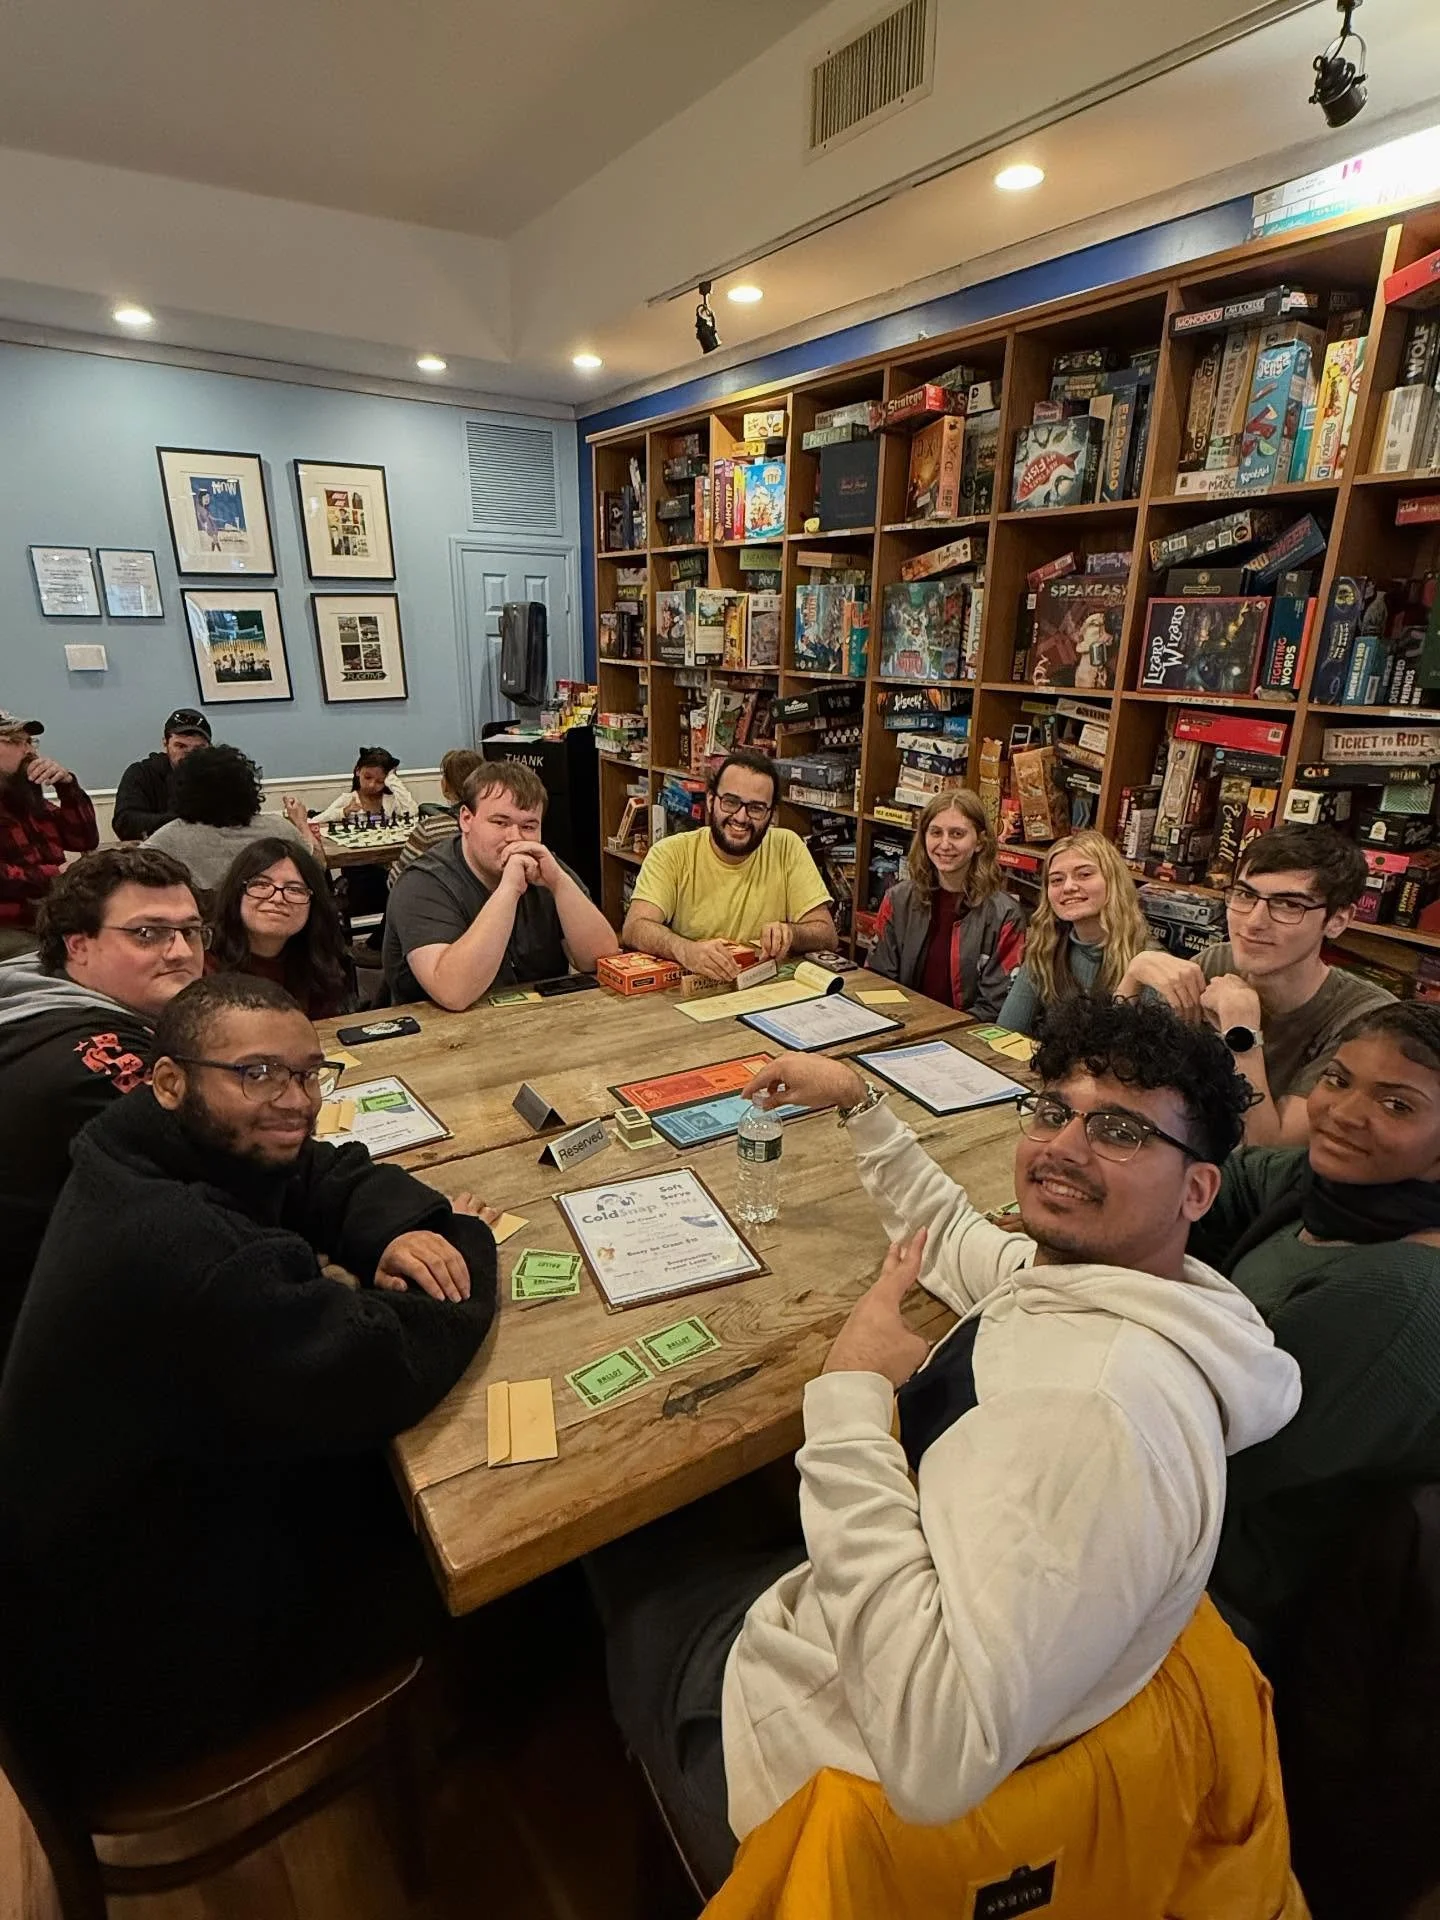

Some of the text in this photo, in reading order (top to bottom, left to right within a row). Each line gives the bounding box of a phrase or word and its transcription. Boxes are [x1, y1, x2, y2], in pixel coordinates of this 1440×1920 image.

[1176, 310, 1222, 329] MONOPOLY
[1407, 325, 1429, 378] WOLF
[887, 391, 924, 415] Stratego
[1108, 426, 1127, 490] DORADO
[211, 481, 237, 497] NOW
[724, 483, 734, 529] IMHOTEP
[1050, 584, 1127, 598] SPEAKEASY
[1271, 636, 1288, 686] FIGHTING
[1280, 645, 1297, 687] WORDS
[347, 671, 385, 681] FUGITIVE
[1388, 659, 1406, 704] DISTURBED
[1400, 669, 1416, 704] FRIENDS
[1332, 732, 1432, 749] TICKET TO RIDE
[505, 753, 545, 768] THANK
[1218, 804, 1244, 863] Everdell
[558, 1130, 605, 1162] Reserved
[659, 1183, 684, 1193] Soft
[660, 1190, 692, 1201] Serve
[666, 1335, 690, 1350] BALLOT
[597, 1368, 623, 1385] BALLOT
